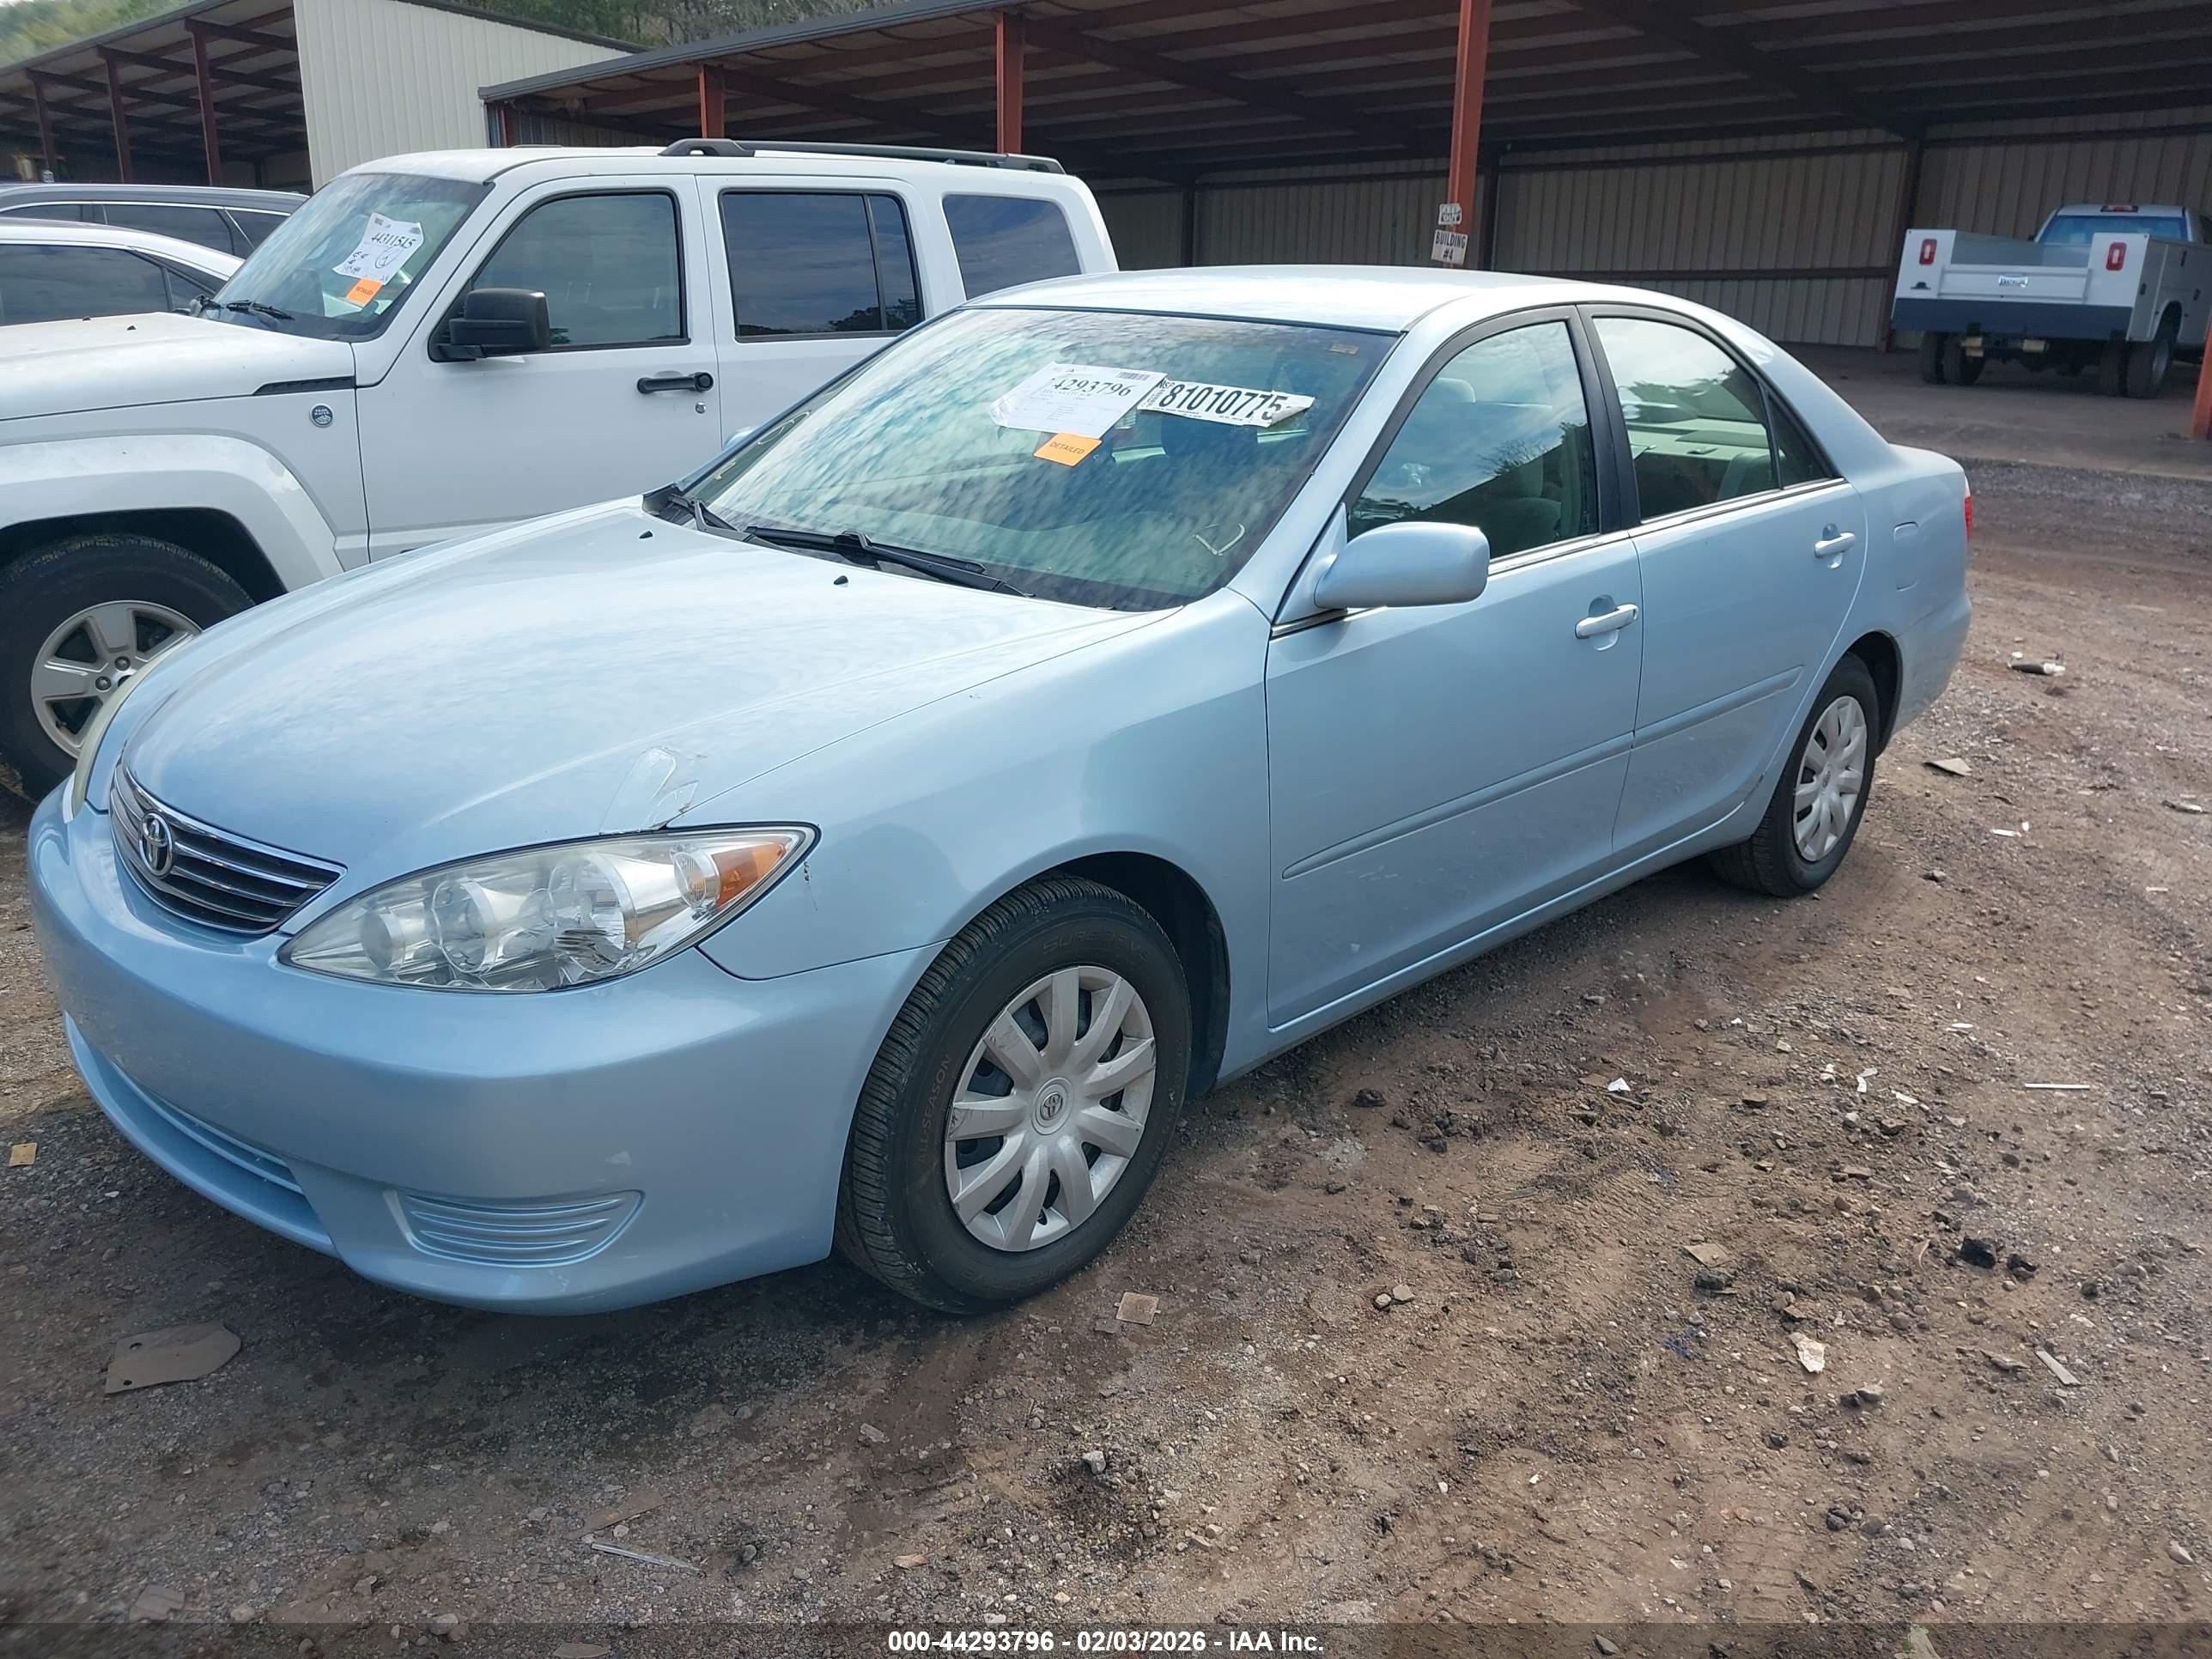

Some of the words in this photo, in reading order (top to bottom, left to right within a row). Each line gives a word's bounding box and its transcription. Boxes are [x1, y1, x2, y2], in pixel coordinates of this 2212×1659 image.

[1436, 232, 1466, 248] BUILDING
[1443, 248, 1454, 261] #4
[1159, 384, 1287, 421] 81010775
[1049, 441, 1085, 454] DETAILED
